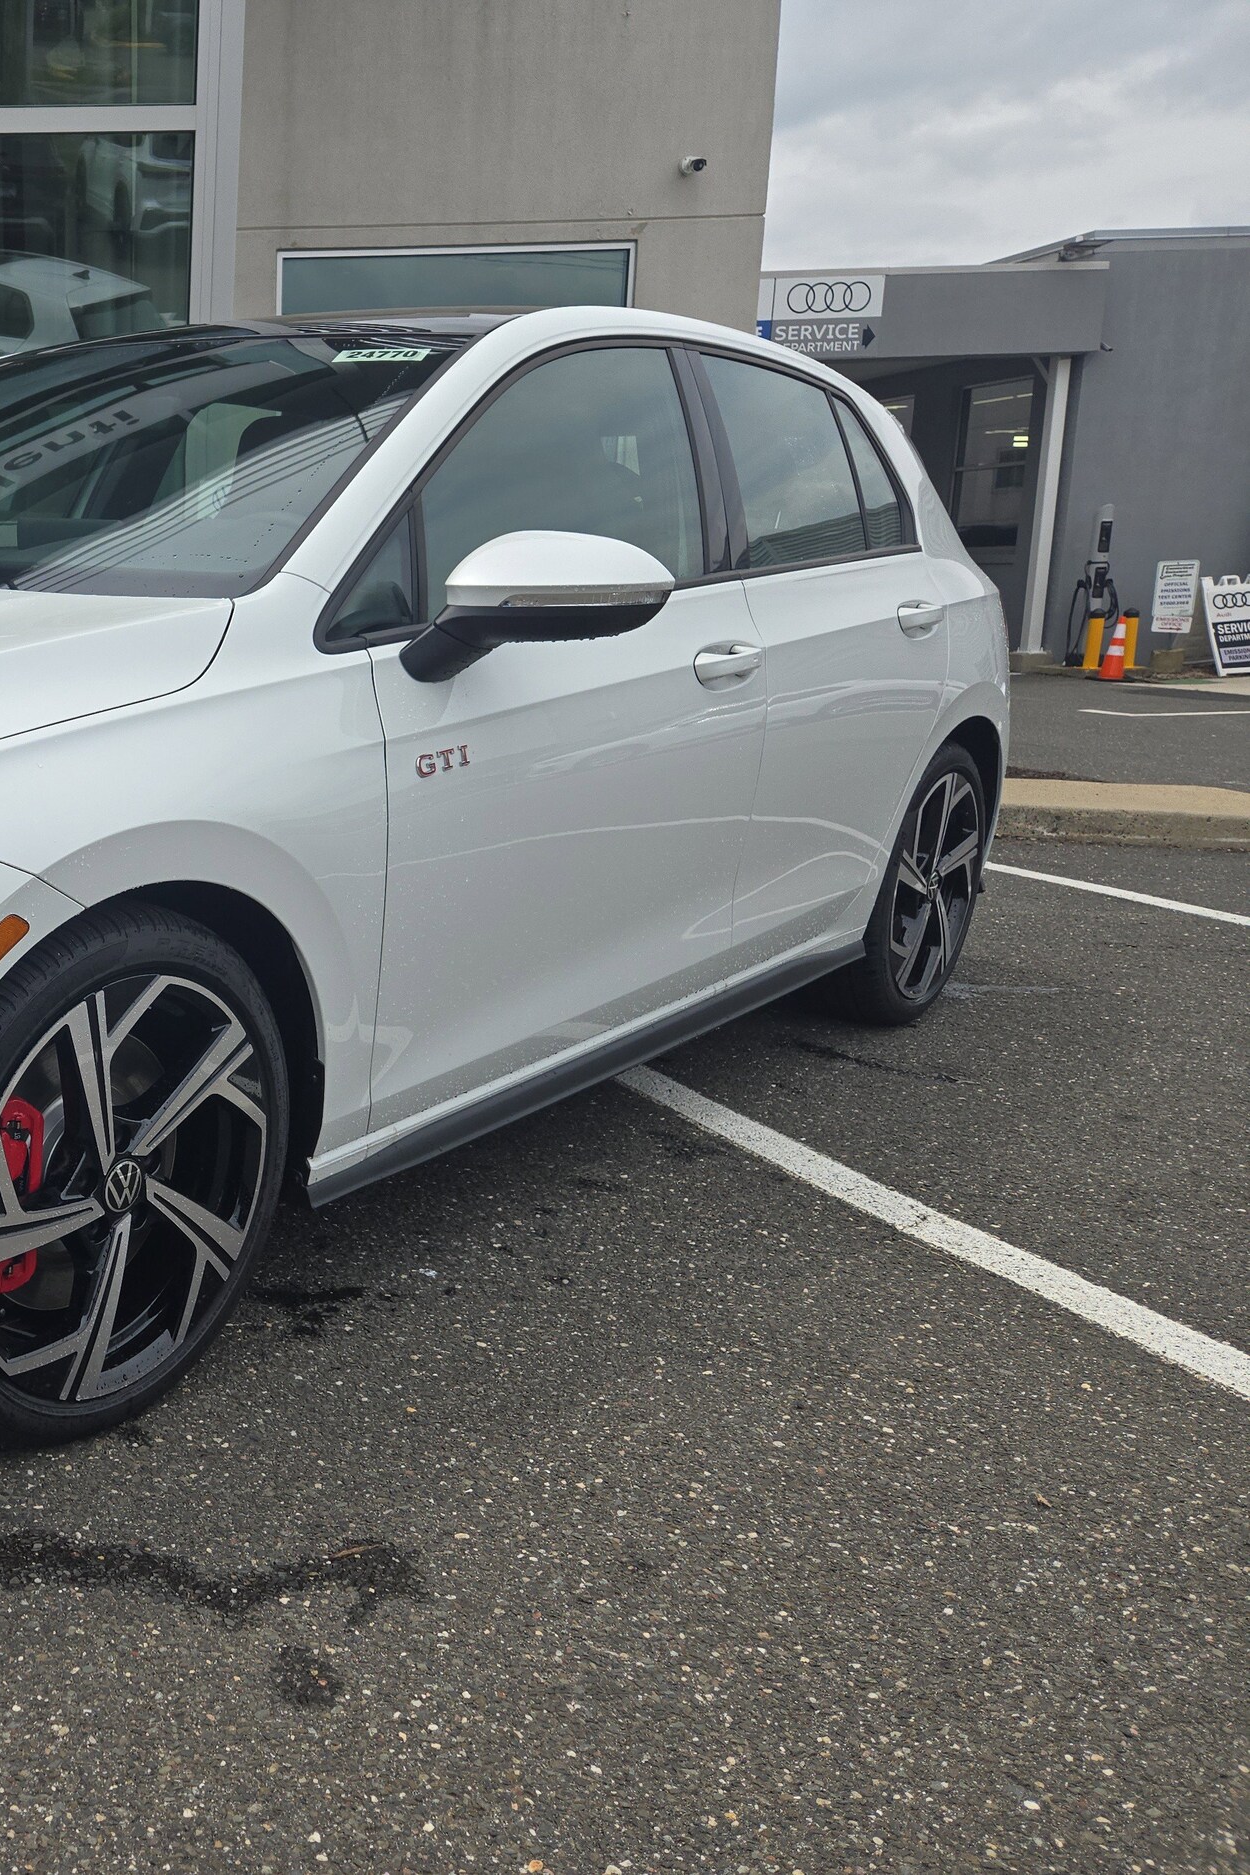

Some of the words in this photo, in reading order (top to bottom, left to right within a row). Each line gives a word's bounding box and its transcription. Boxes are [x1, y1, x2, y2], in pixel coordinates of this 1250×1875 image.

[775, 324, 860, 341] SERVICE
[346, 350, 418, 358] 24770
[416, 744, 470, 778] GTI
